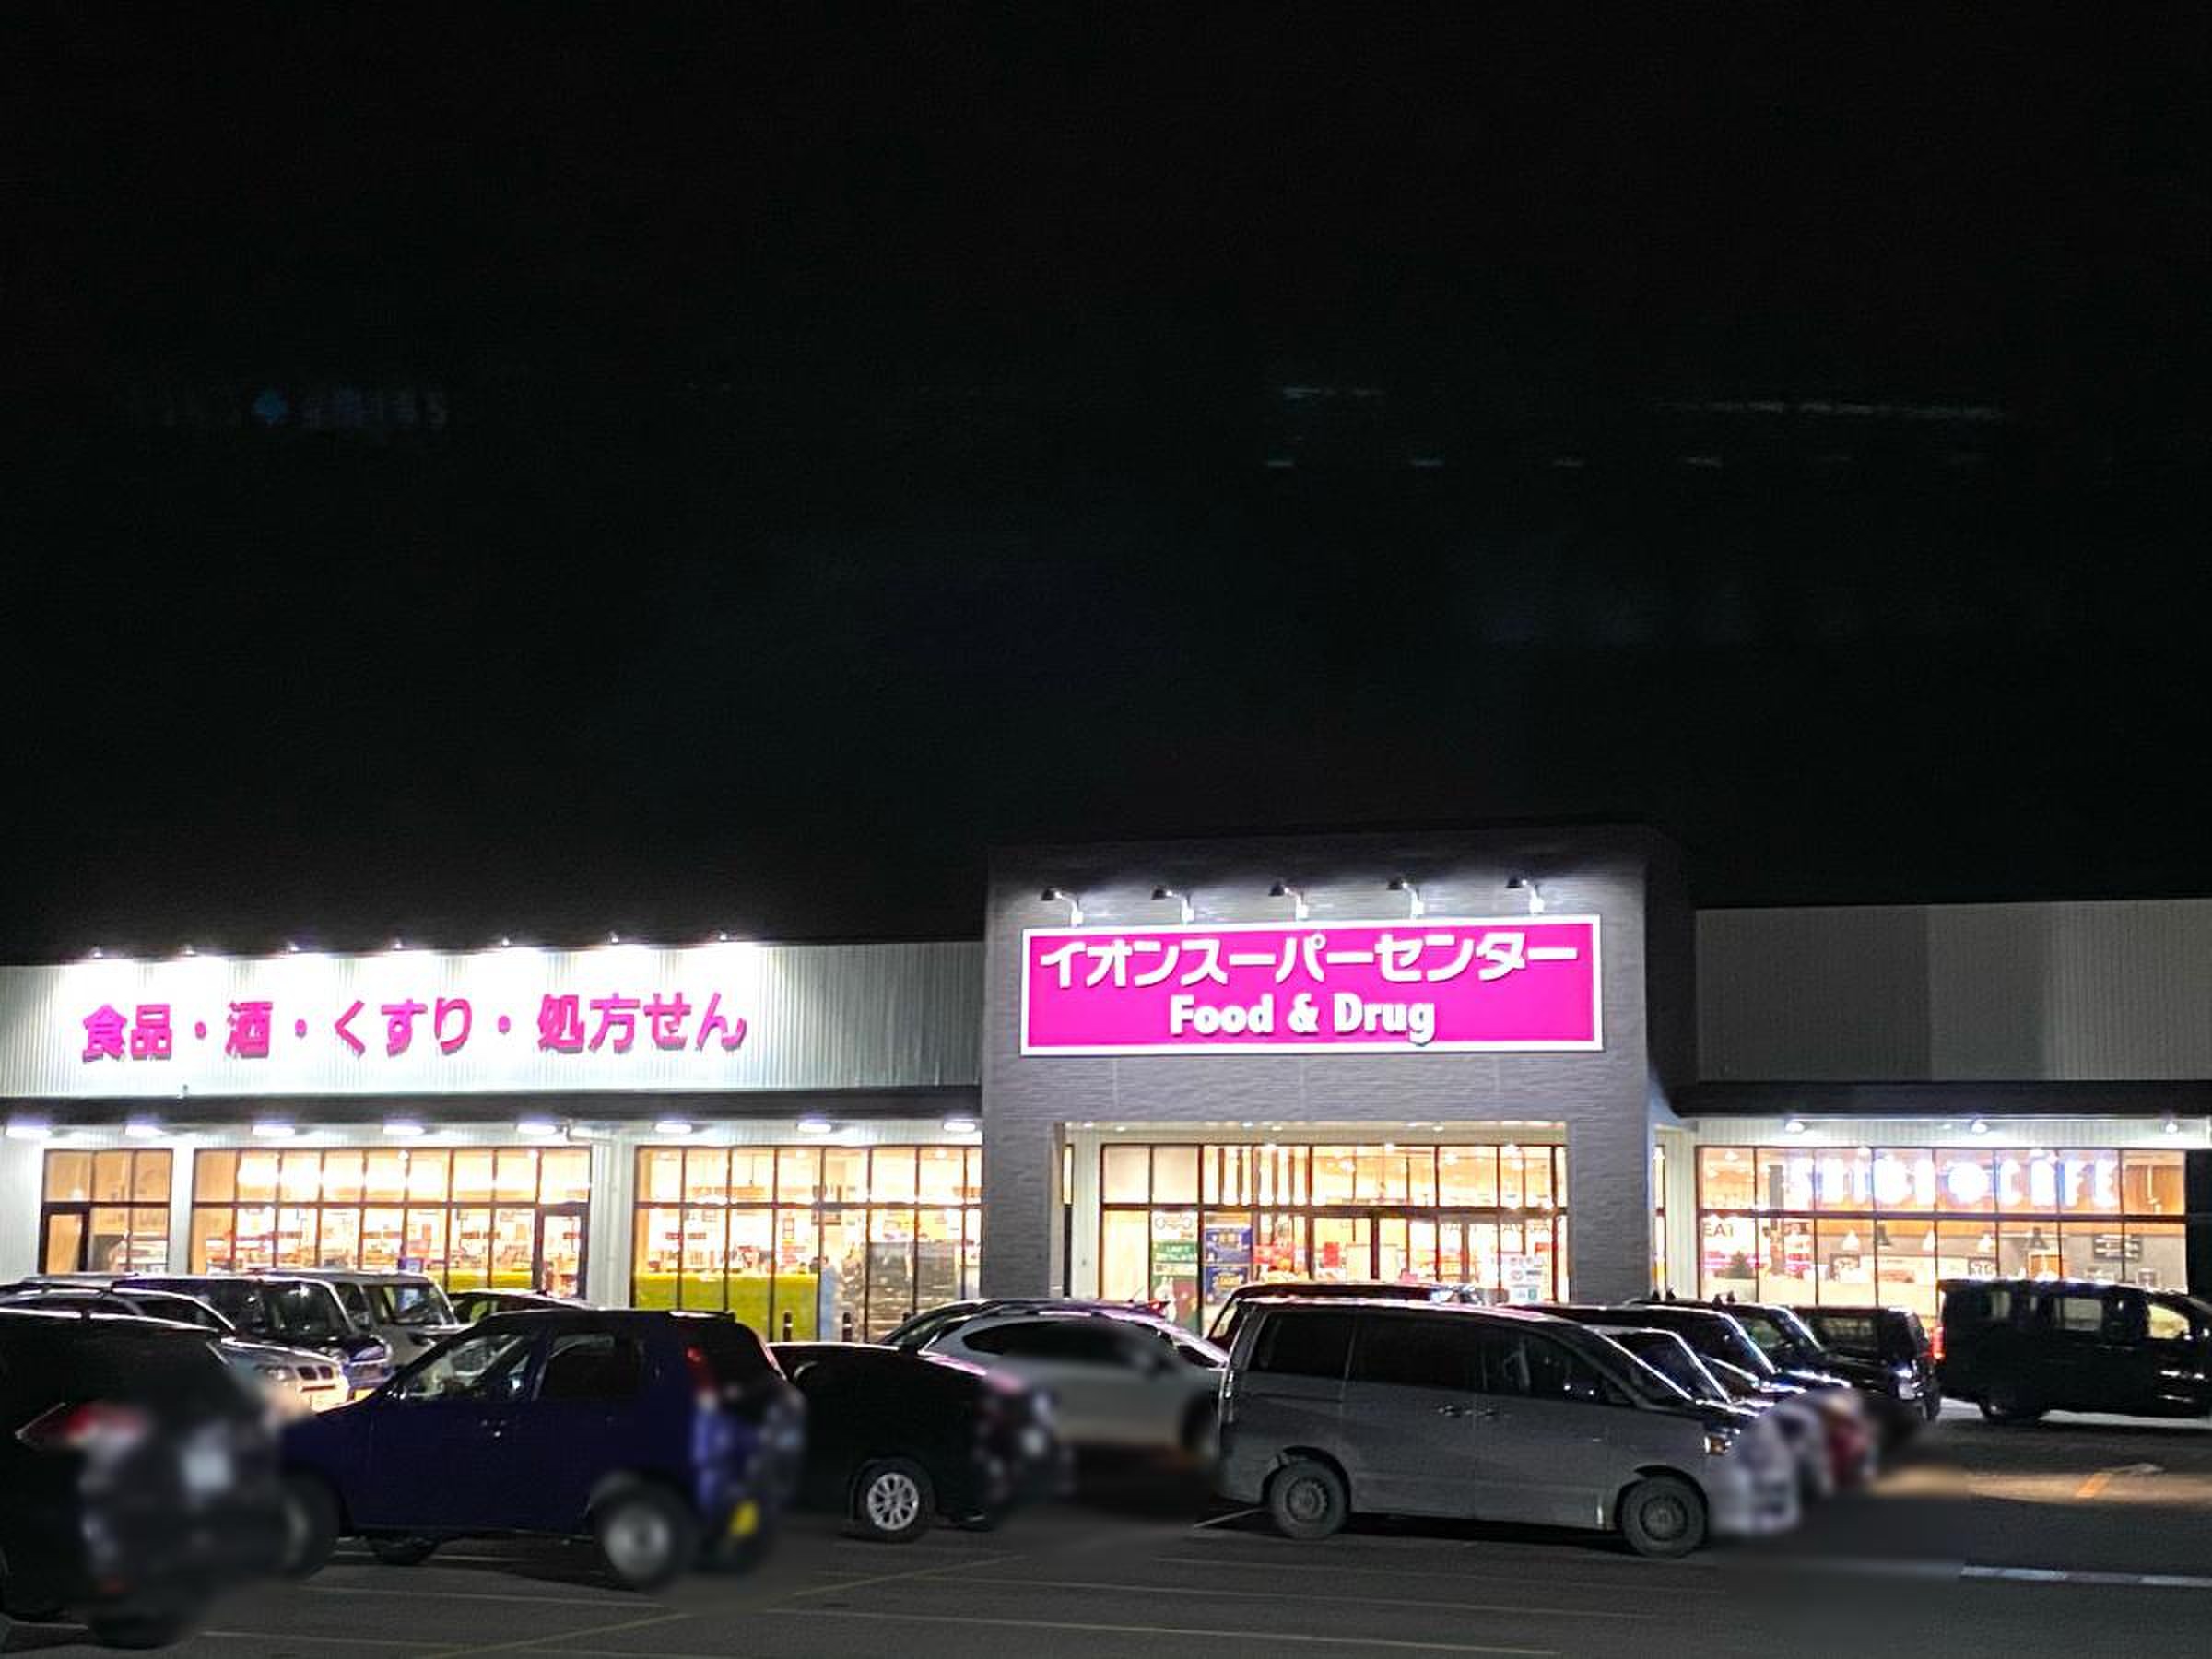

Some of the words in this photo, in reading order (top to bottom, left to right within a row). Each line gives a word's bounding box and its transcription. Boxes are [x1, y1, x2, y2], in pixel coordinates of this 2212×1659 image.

[1040, 931, 1579, 988] イオンスーパーセンター
[1169, 994, 1273, 1036] Food
[1287, 995, 1320, 1035] &
[1334, 993, 1436, 1044] Drug
